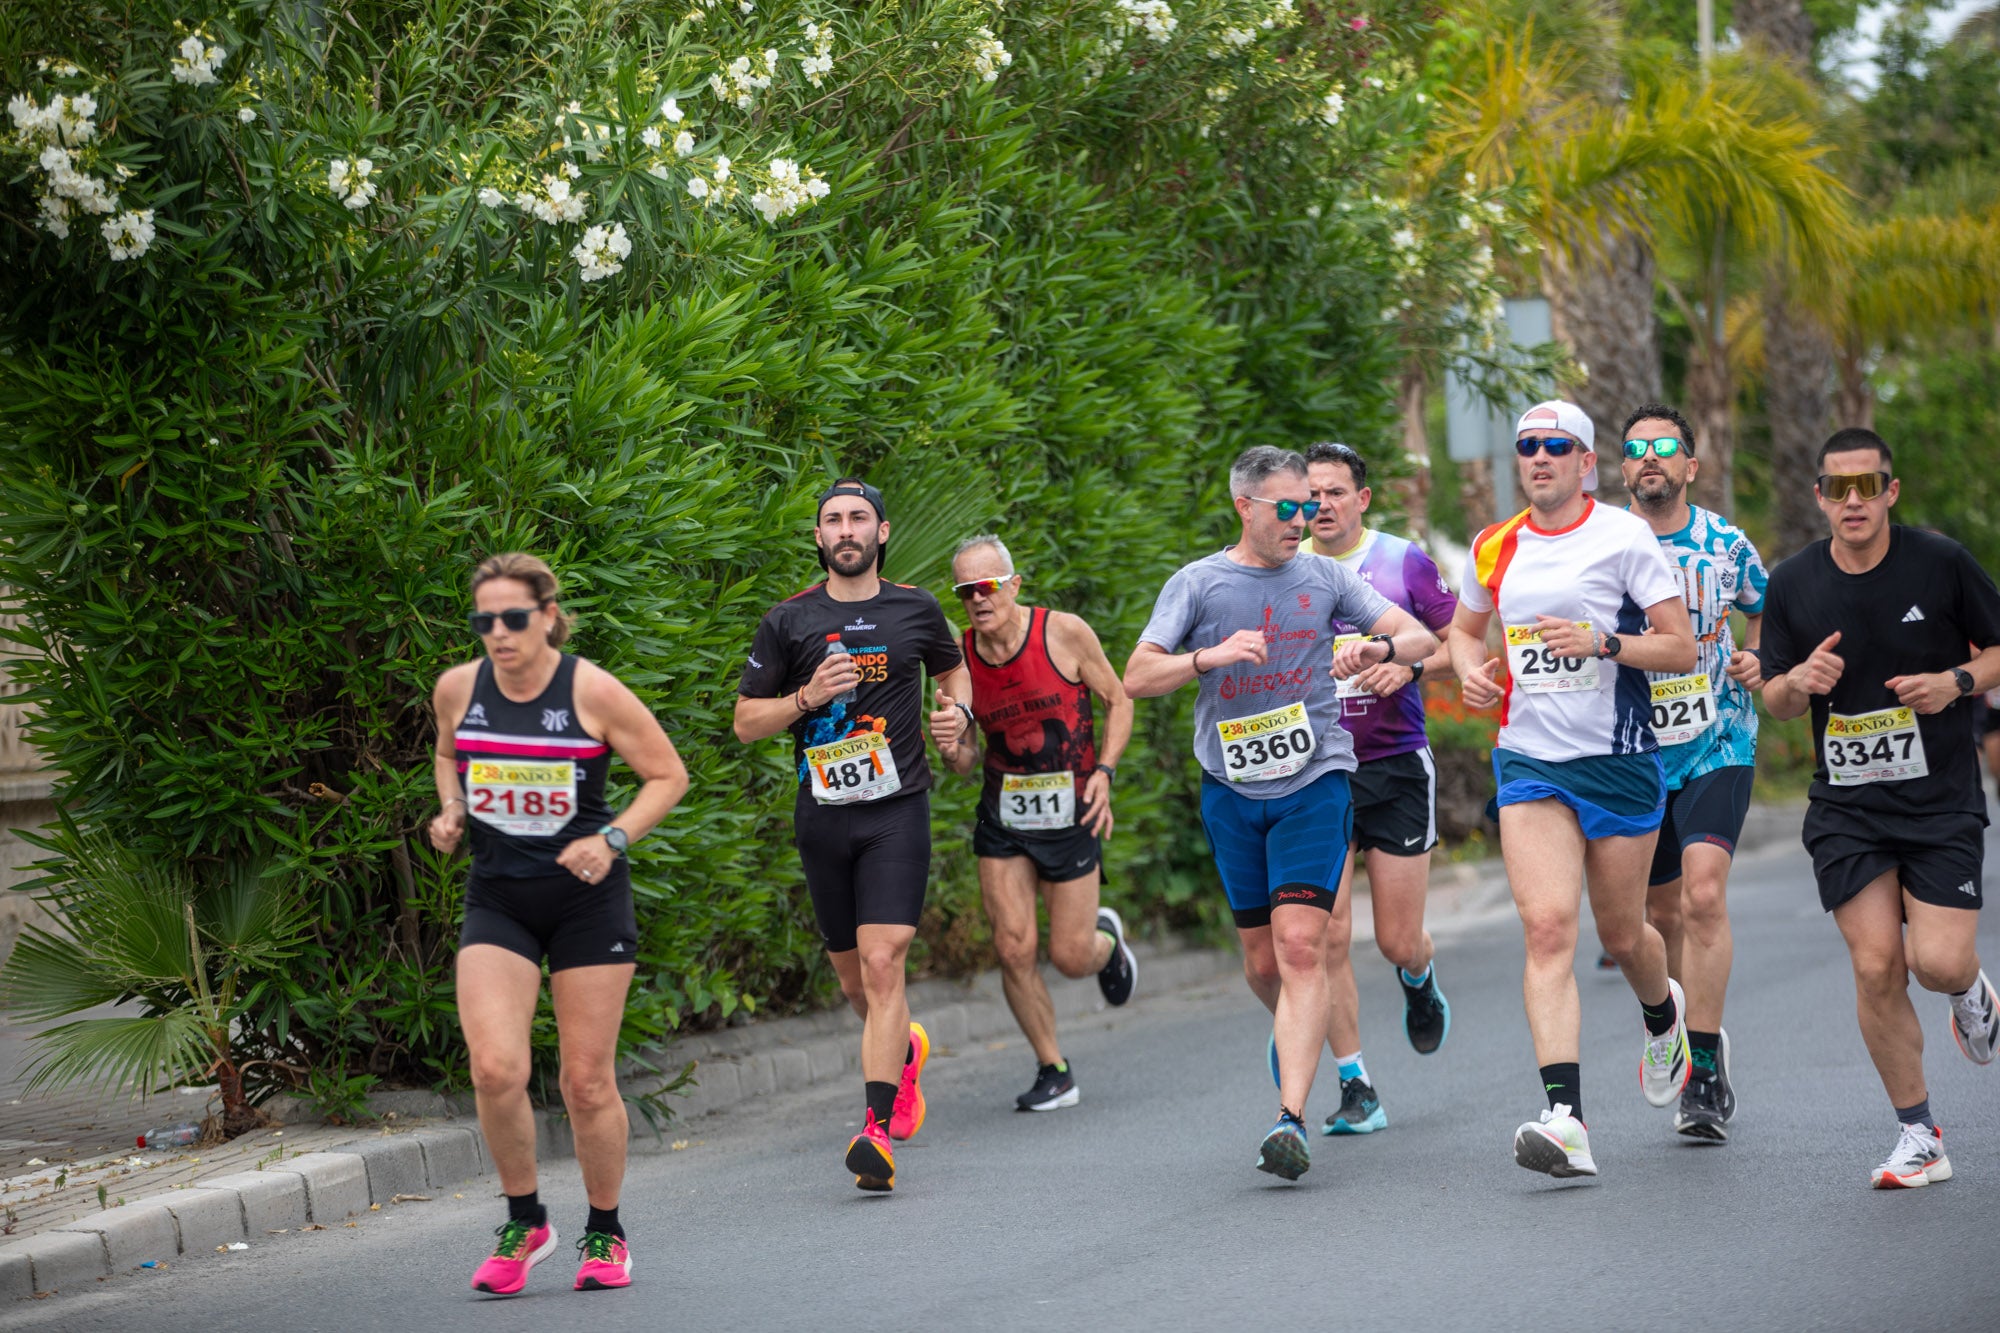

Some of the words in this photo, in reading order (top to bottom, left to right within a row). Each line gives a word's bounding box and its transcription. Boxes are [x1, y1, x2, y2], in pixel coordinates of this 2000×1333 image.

[1280, 629, 1317, 641] FONDO
[859, 645, 888, 653] PREMIO
[849, 653, 888, 666] ONDO
[852, 666, 888, 682] 025
[1655, 684, 1692, 697] ONDO
[1650, 697, 1708, 729] 021
[1230, 723, 1243, 735] 38
[1243, 716, 1288, 734] FONDO
[1844, 718, 1894, 733] FONDO
[827, 741, 869, 759] FONDO
[1227, 728, 1311, 770] 3360
[1828, 732, 1915, 767] 3347
[826, 757, 876, 791] 487
[473, 788, 571, 817] 2185
[1012, 793, 1060, 815] 311
